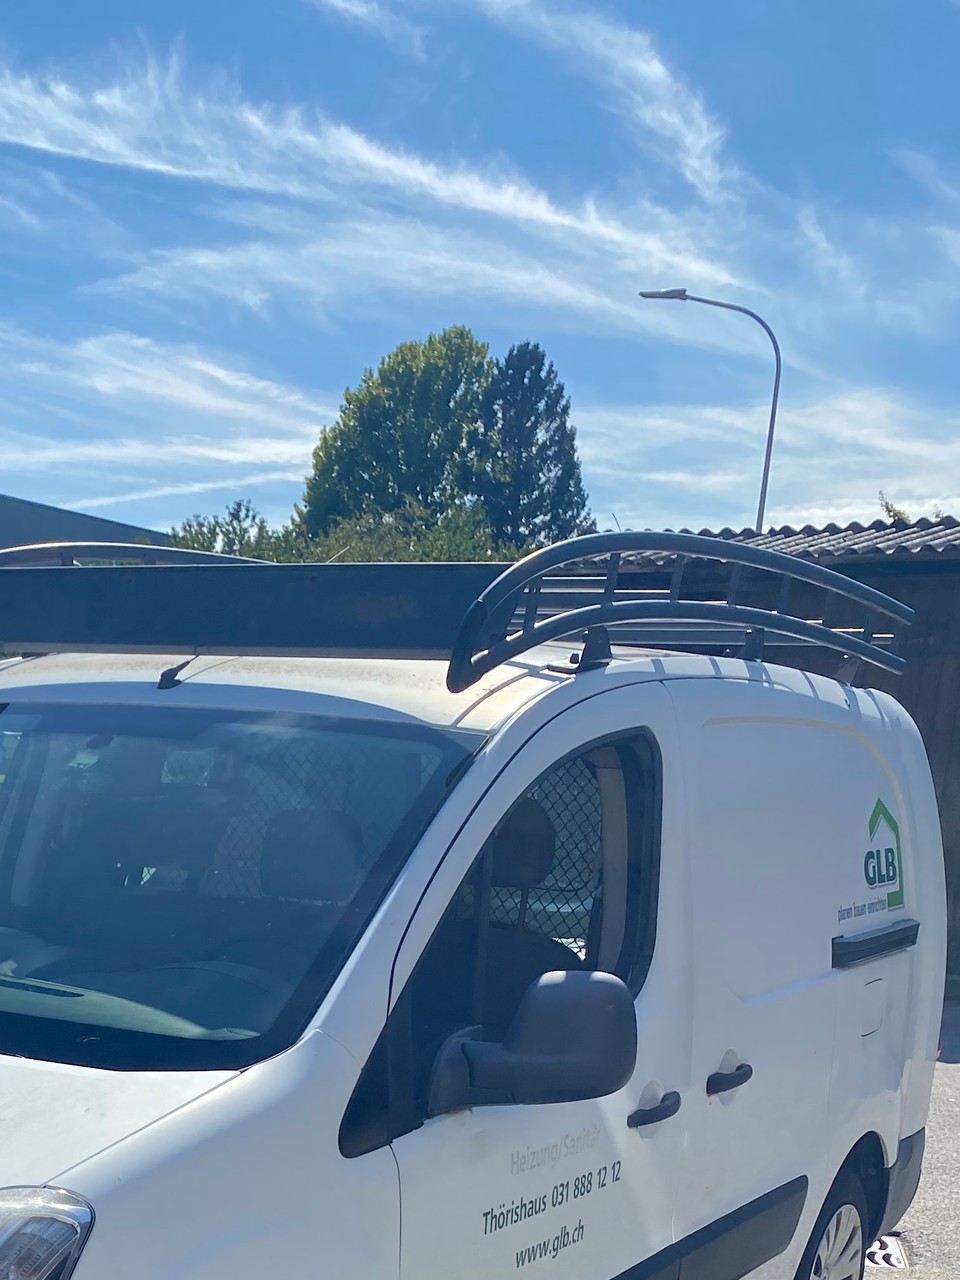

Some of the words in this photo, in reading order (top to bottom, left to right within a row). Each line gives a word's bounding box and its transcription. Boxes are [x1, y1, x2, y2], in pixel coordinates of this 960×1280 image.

[864, 847, 897, 886] GLB
[838, 904, 853, 925] planen
[853, 901, 867, 917] bauen
[510, 1127, 601, 1176] Heizung/Sanitär
[482, 1193, 547, 1235] Thörishaus
[551, 1180, 569, 1208] 031
[573, 1171, 593, 1199] 888
[597, 1165, 607, 1189] 12
[611, 1160, 621, 1183] 12
[515, 1219, 585, 1269] www.glb.ch
